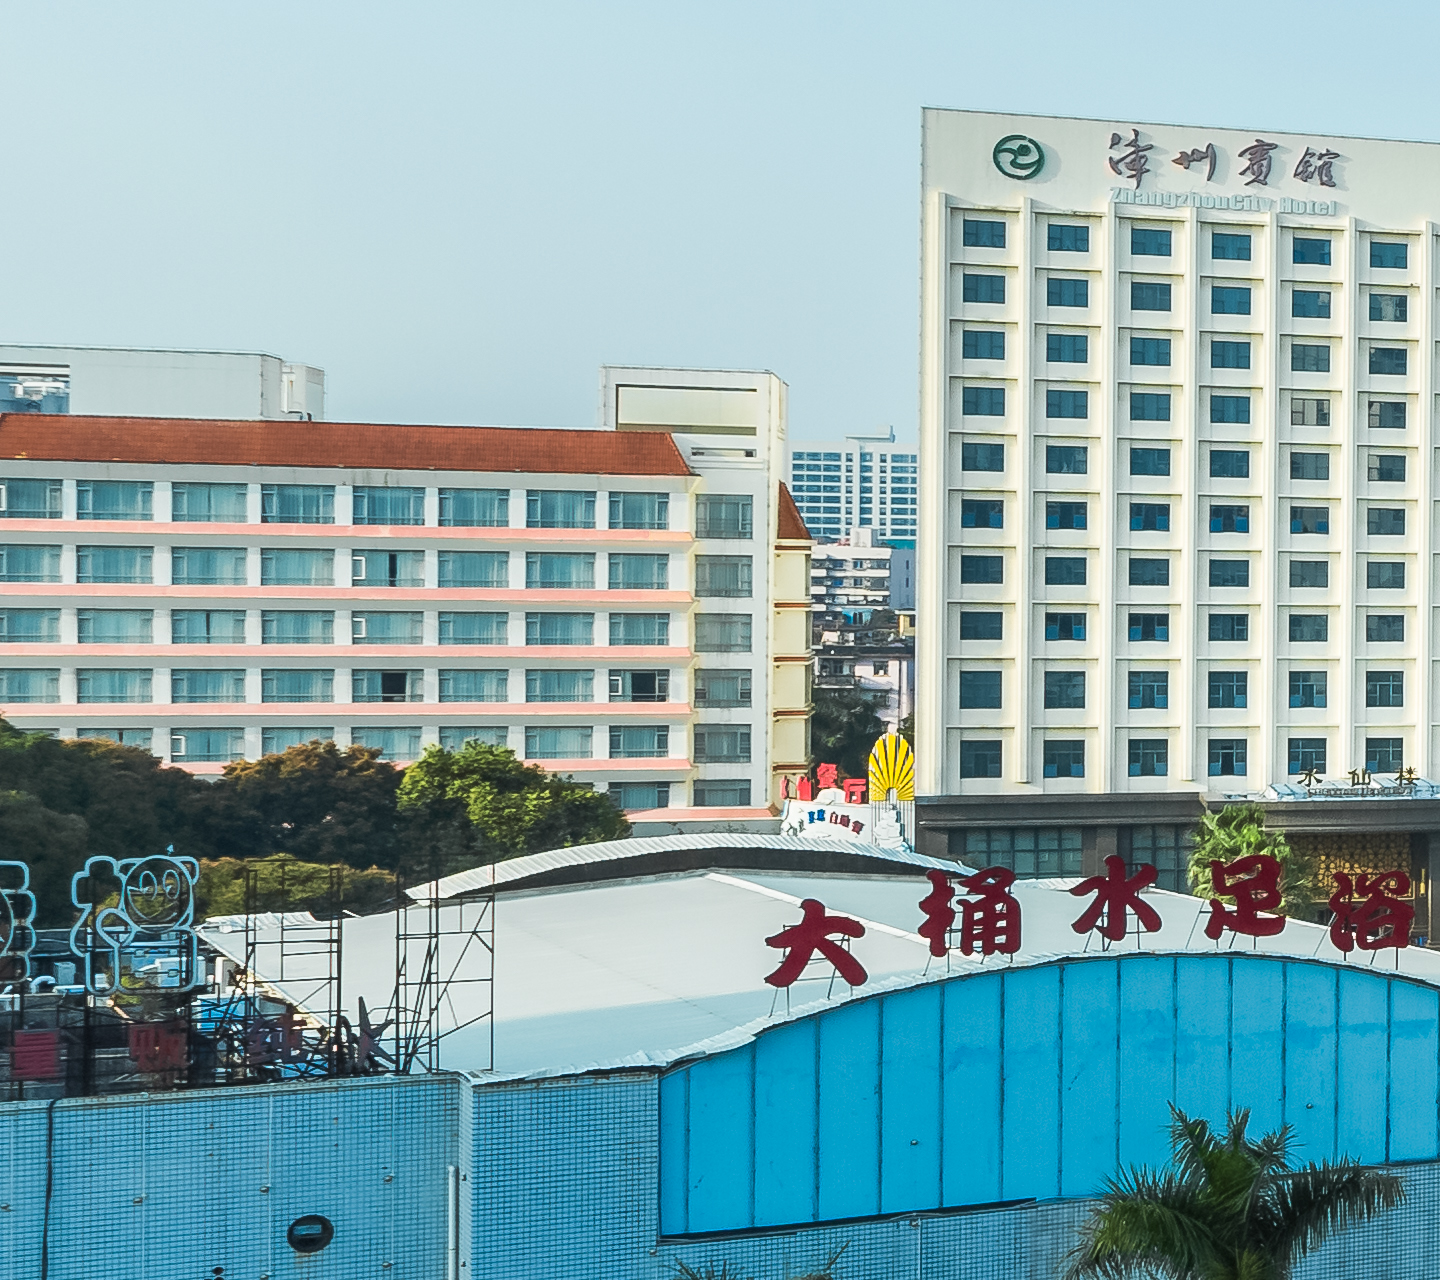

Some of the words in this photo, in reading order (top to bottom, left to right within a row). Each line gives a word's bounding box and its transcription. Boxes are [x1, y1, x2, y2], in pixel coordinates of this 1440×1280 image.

[1278, 197, 1337, 216] Hotel
[1296, 765, 1421, 787] 水仙楼
[764, 853, 1416, 988] 大桶水足浴
